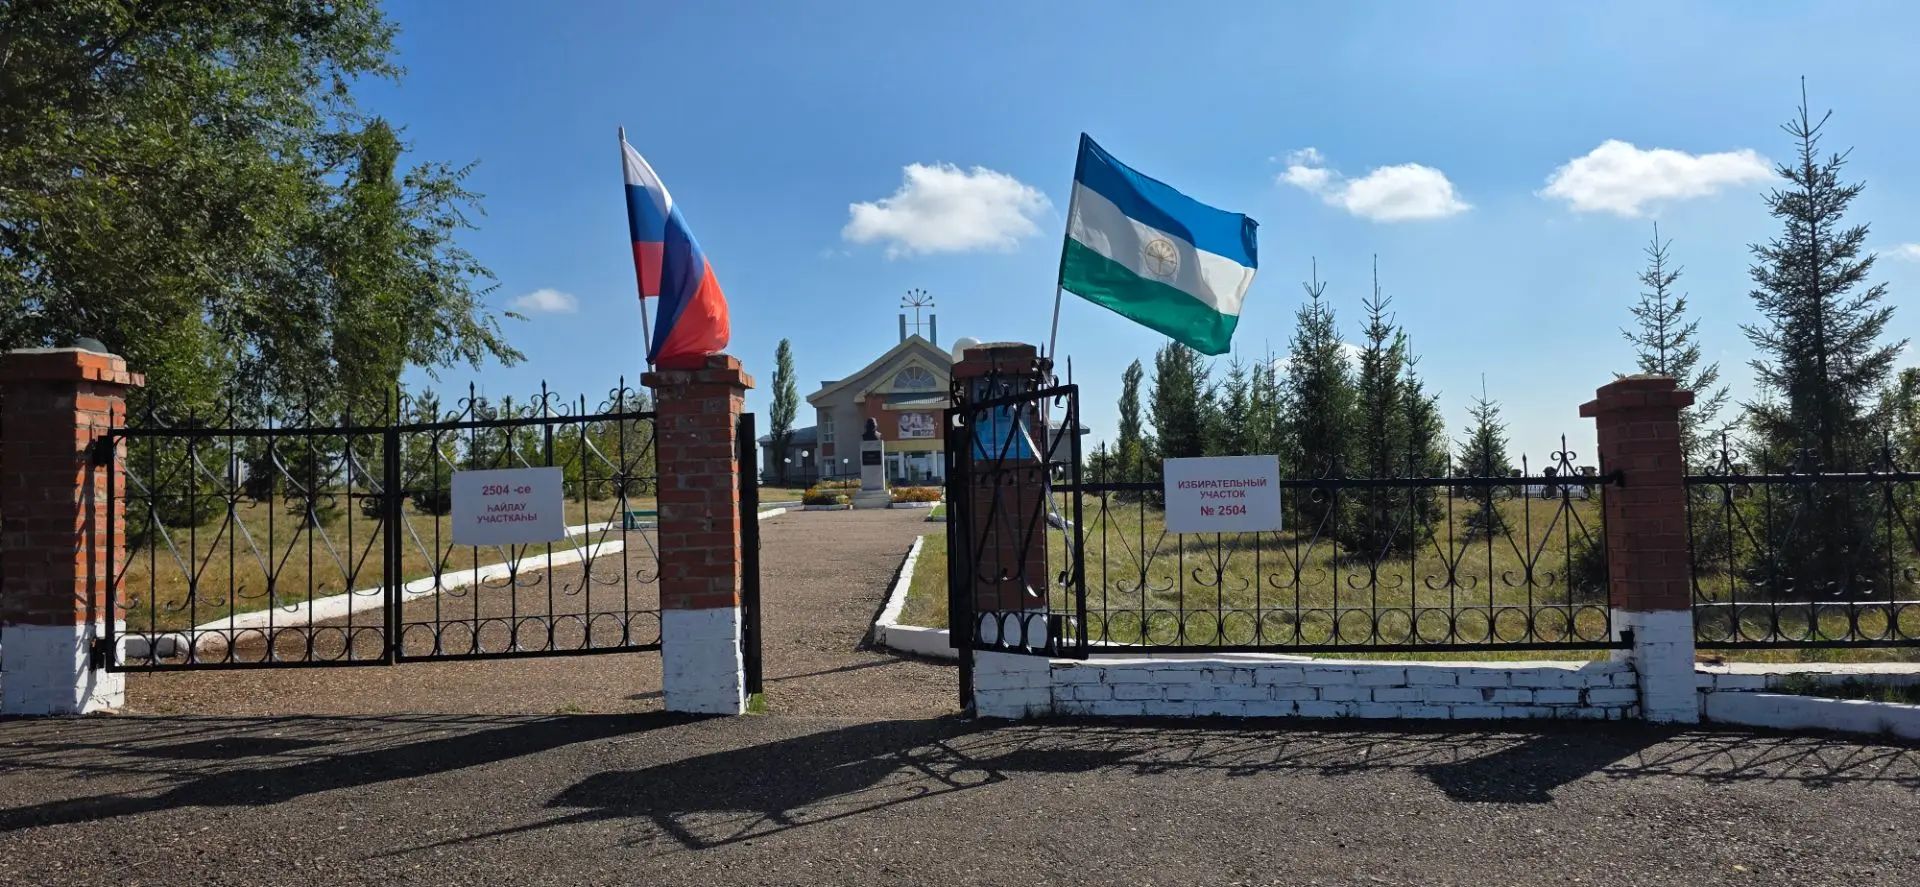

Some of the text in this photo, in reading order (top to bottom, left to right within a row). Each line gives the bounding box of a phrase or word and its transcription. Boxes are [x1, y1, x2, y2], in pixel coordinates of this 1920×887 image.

[1178, 477, 1267, 489] ИЗБИРАТЕЛЬНЫЙ
[482, 485, 509, 496] 2504
[1200, 490, 1246, 500] УЧАСТОК
[1200, 504, 1247, 516] № 2504
